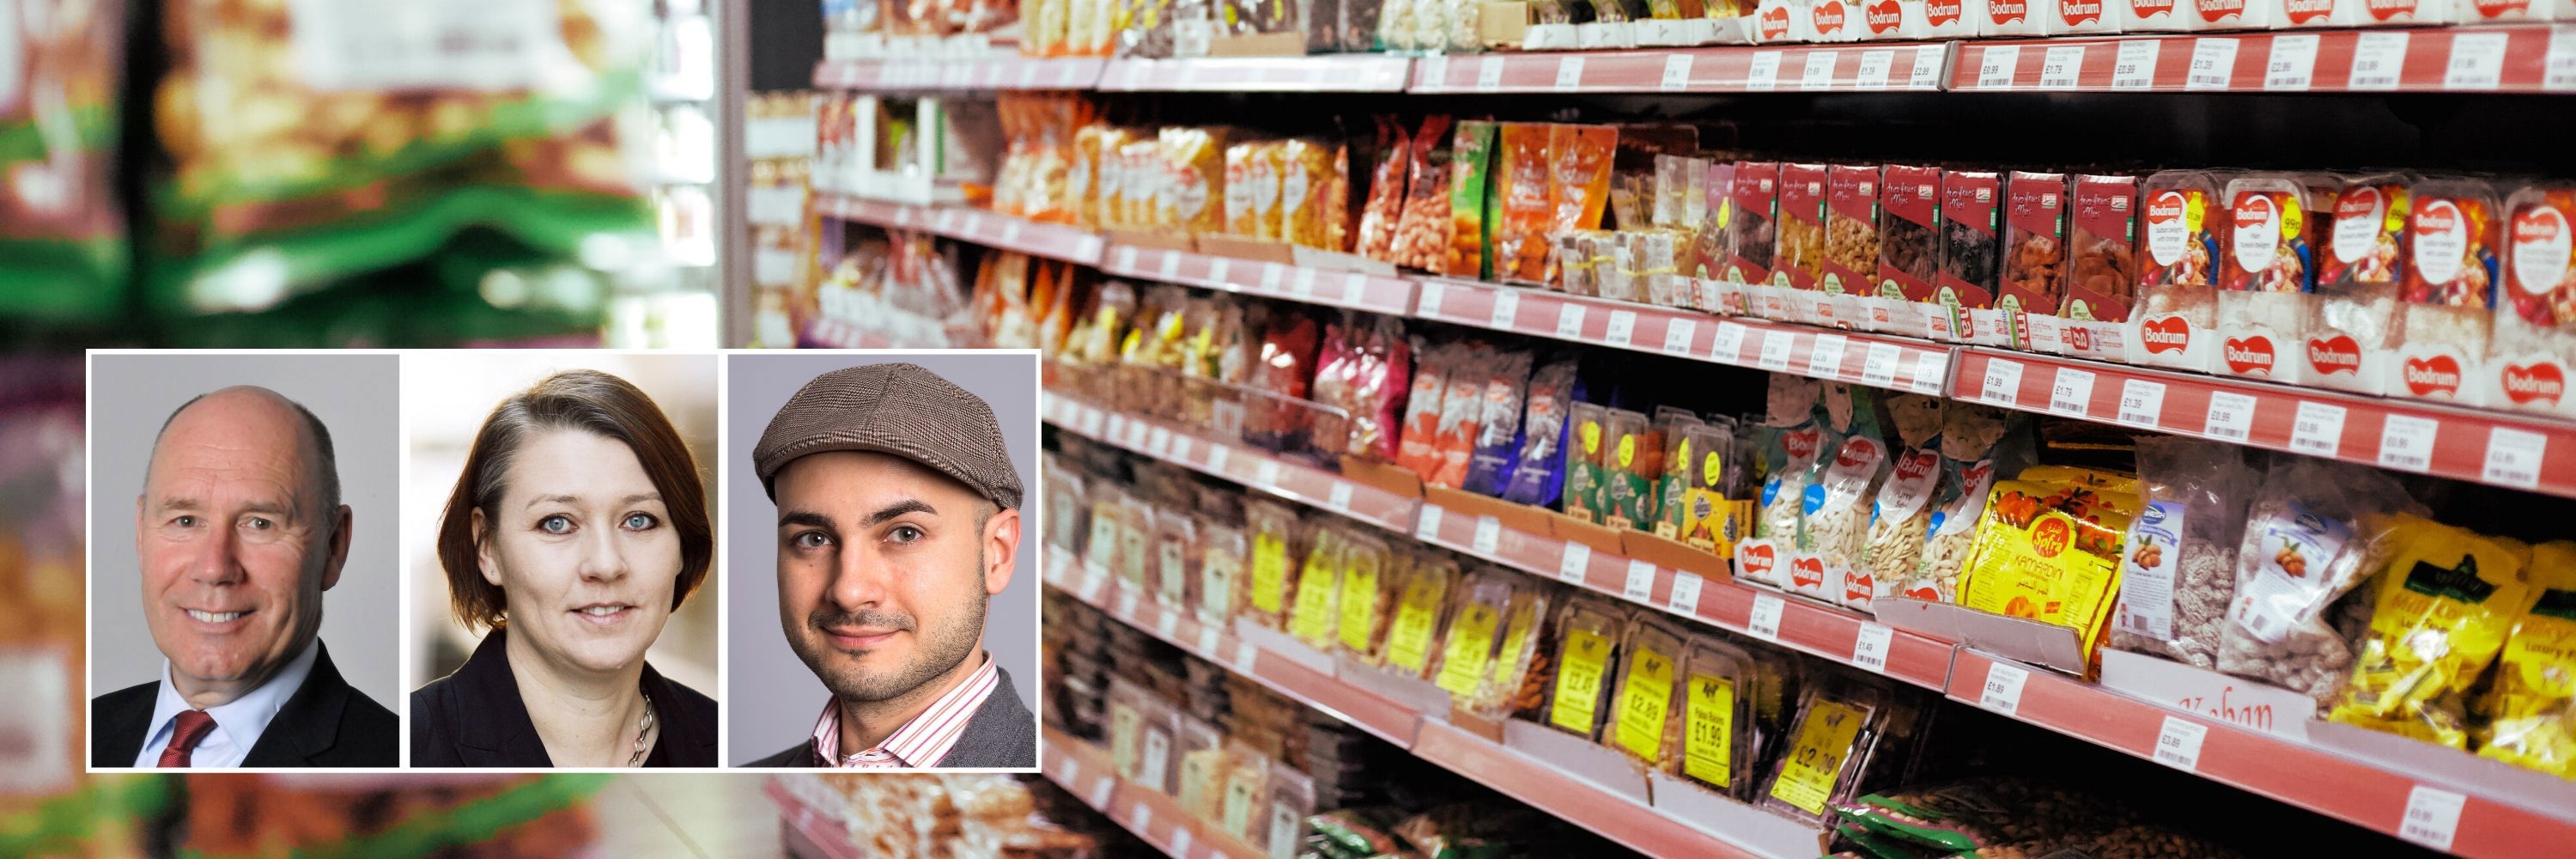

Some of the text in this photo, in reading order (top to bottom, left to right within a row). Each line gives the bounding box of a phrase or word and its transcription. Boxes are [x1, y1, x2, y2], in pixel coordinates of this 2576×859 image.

[1928, 3, 1959, 17] Bodrum
[1990, 0, 2025, 15] Bodrum
[2063, 0, 2100, 15] Bodrum
[1815, 12, 1843, 24] Bodrum
[1868, 9, 1899, 24] Bodrum
[1762, 18, 1788, 31] Bodrum
[1984, 65, 1998, 74] £0.99
[2045, 65, 2062, 74] £1.79
[2150, 204, 2179, 216] Bodrum
[2236, 208, 2268, 221] Bodrum
[2144, 326, 2186, 344] Bodrum
[2227, 346, 2272, 365] Bodrum
[2310, 346, 2358, 366] Bodrum
[1986, 375, 2003, 387] £1.99
[2408, 365, 2458, 387] Bodrum
[2507, 372, 2561, 395] Bodrum
[2033, 530, 2063, 554] Sofra
[1744, 549, 1772, 567] Bodrum
[1793, 562, 1822, 583] Bodrum
[1988, 681, 2005, 694] £1.89
